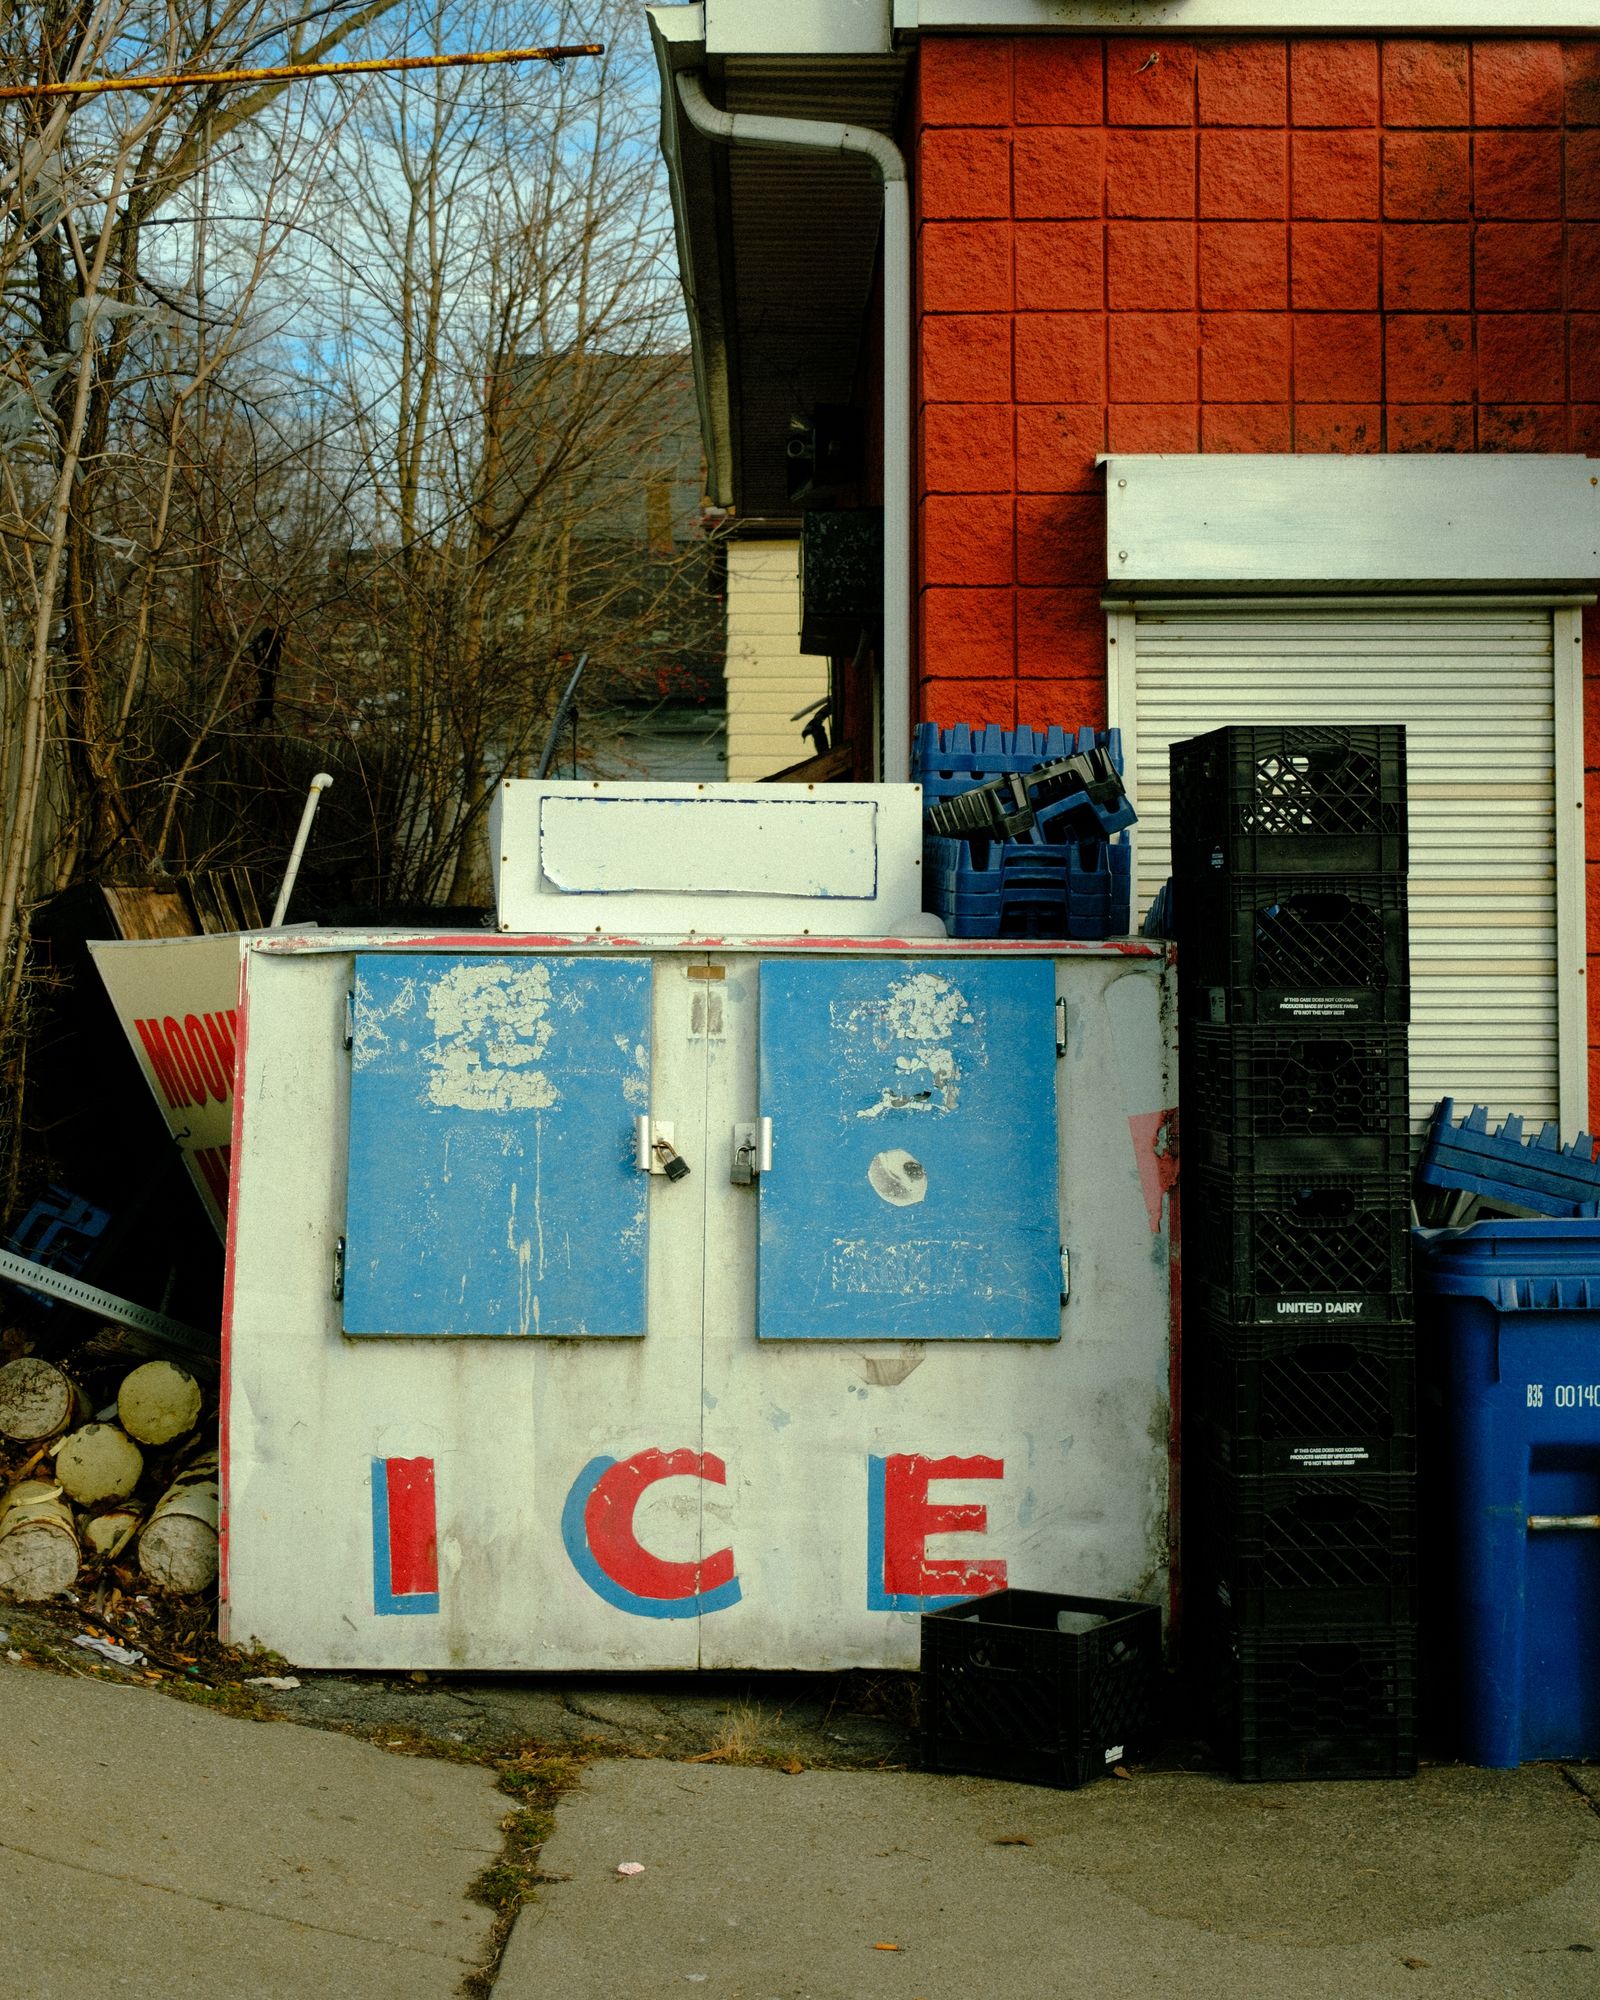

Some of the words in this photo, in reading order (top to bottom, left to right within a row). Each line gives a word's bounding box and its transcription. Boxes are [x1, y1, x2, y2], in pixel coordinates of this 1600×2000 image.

[1276, 1302, 1323, 1314] UNITED
[1325, 1302, 1363, 1314] DAIRY
[372, 1446, 1008, 1619] ICE
